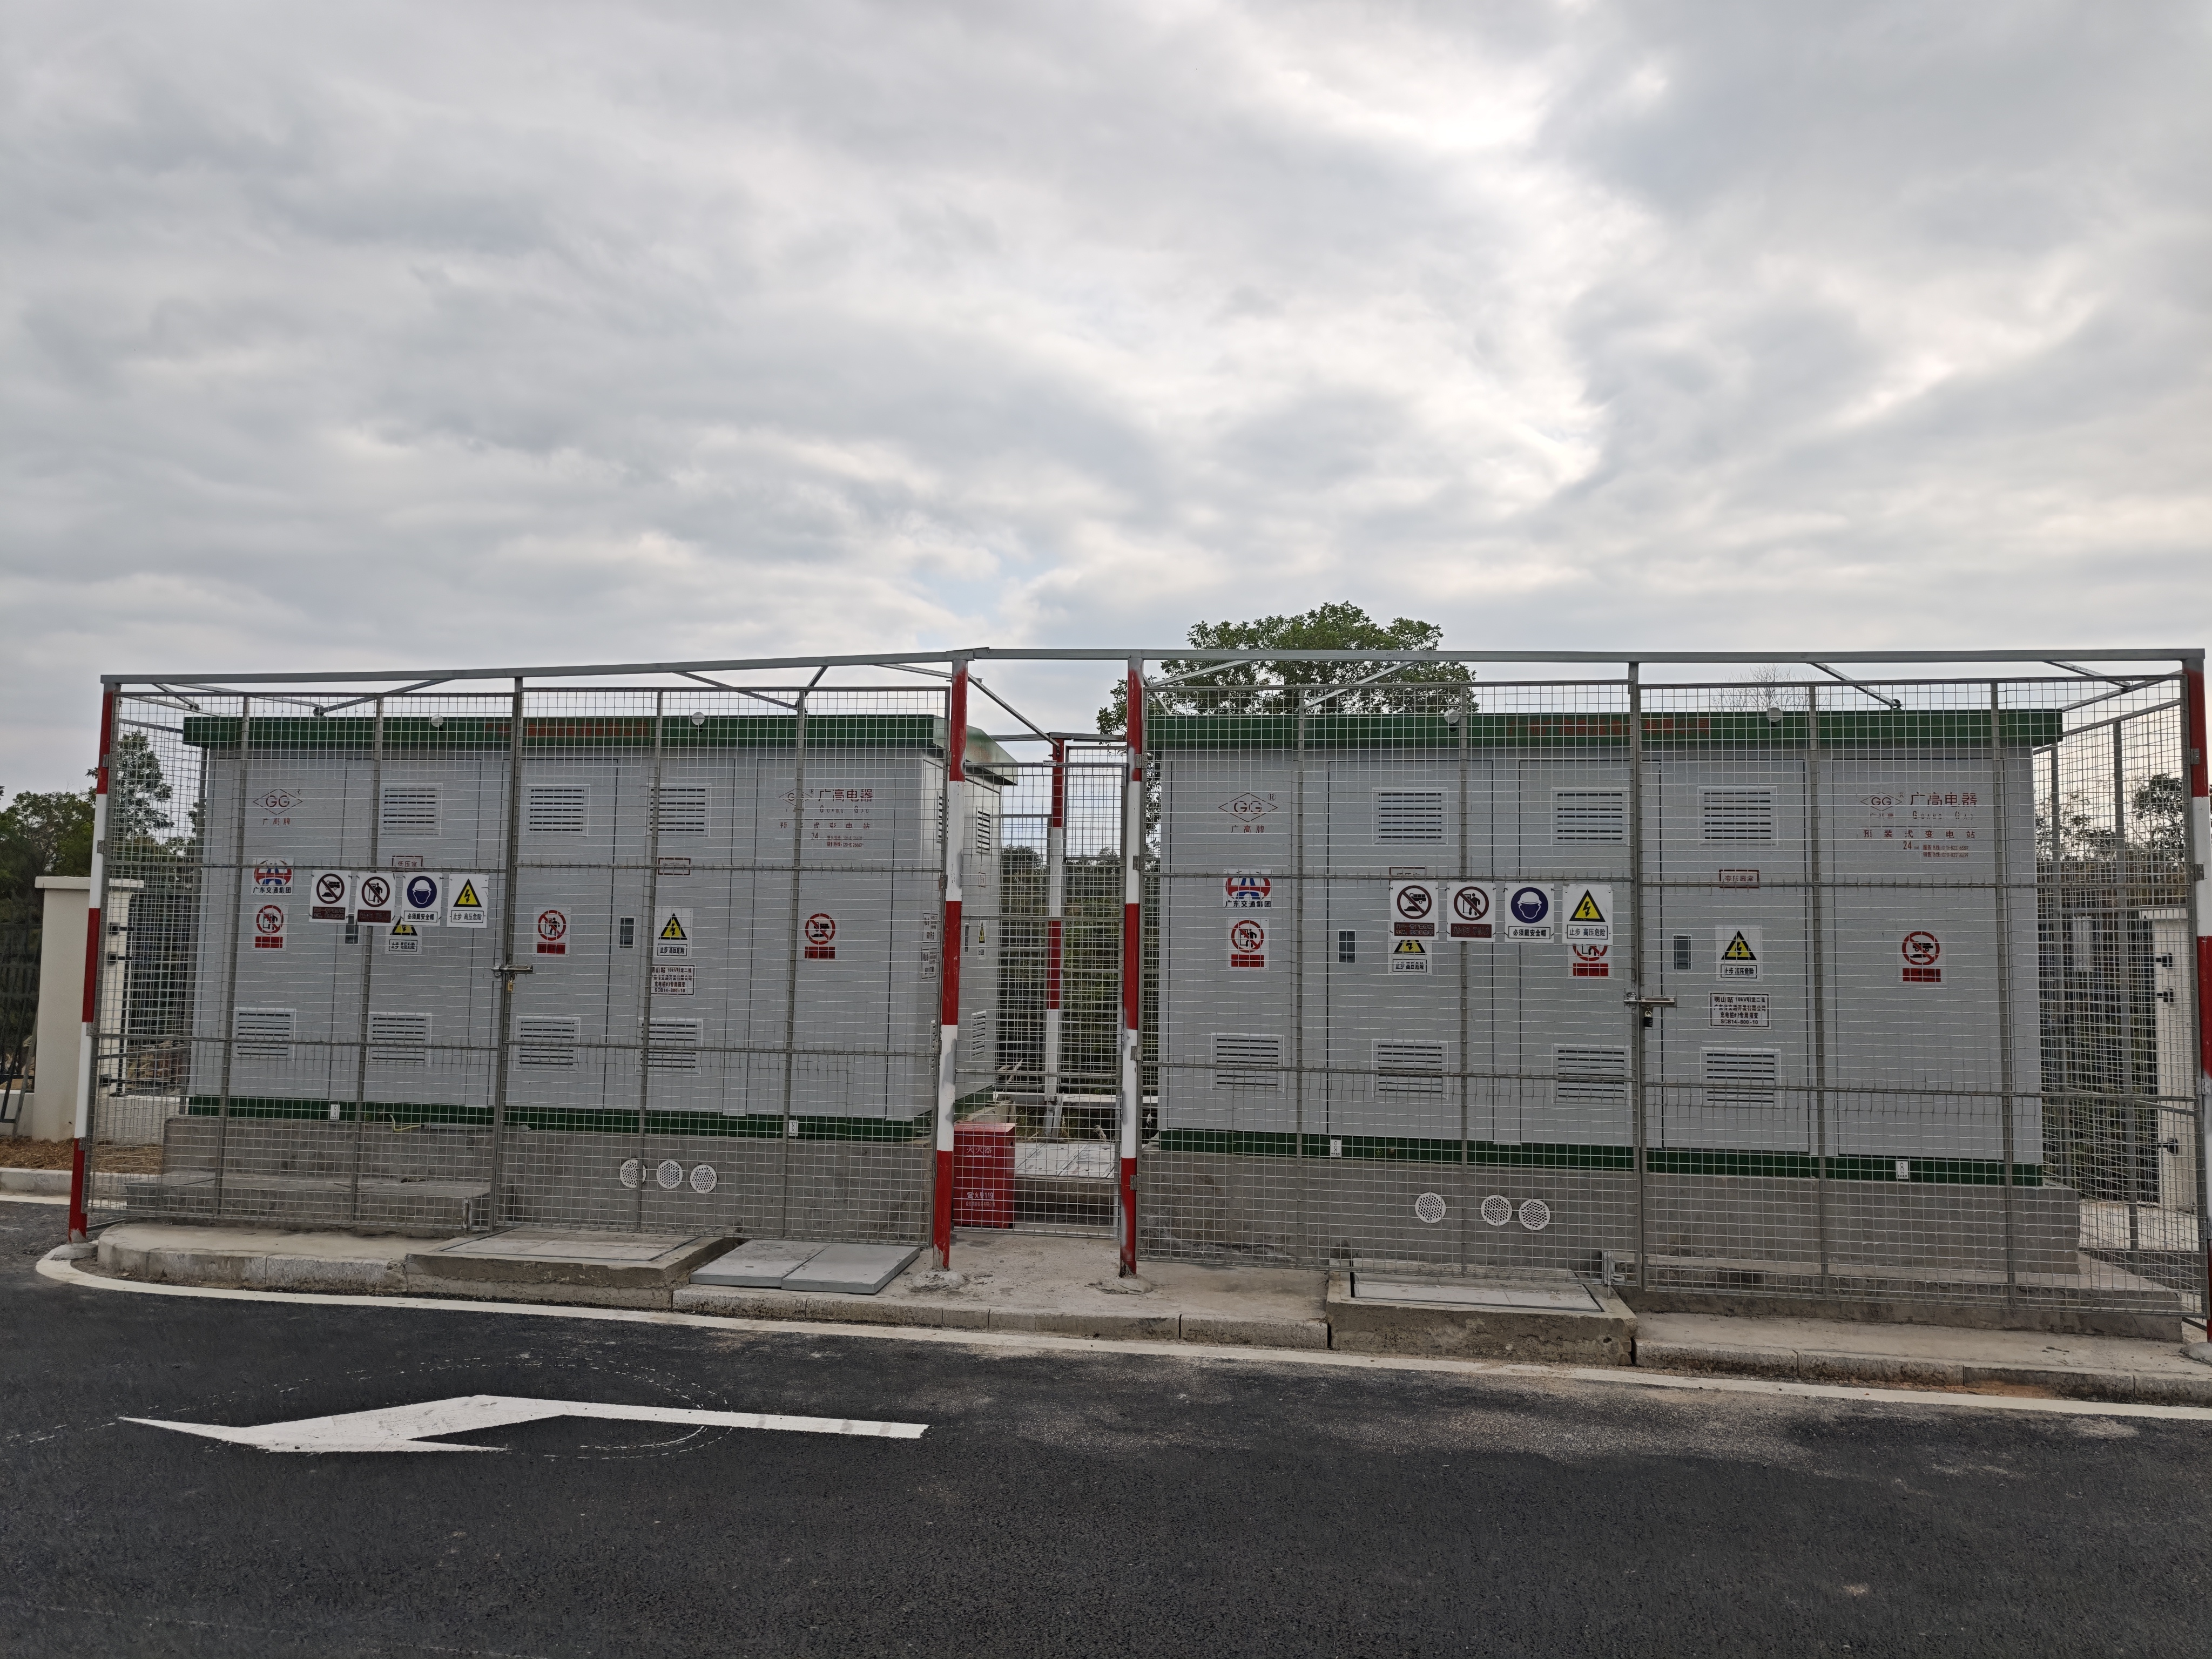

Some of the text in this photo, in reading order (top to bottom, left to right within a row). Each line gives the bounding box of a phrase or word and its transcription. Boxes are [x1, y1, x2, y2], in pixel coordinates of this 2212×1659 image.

[266, 795, 290, 807] GG
[818, 788, 873, 802] 广高电器
[1871, 797, 1892, 805] GG
[1910, 792, 1977, 807] 广高电器
[1234, 800, 1263, 814] GG
[1569, 928, 1581, 936] 止步
